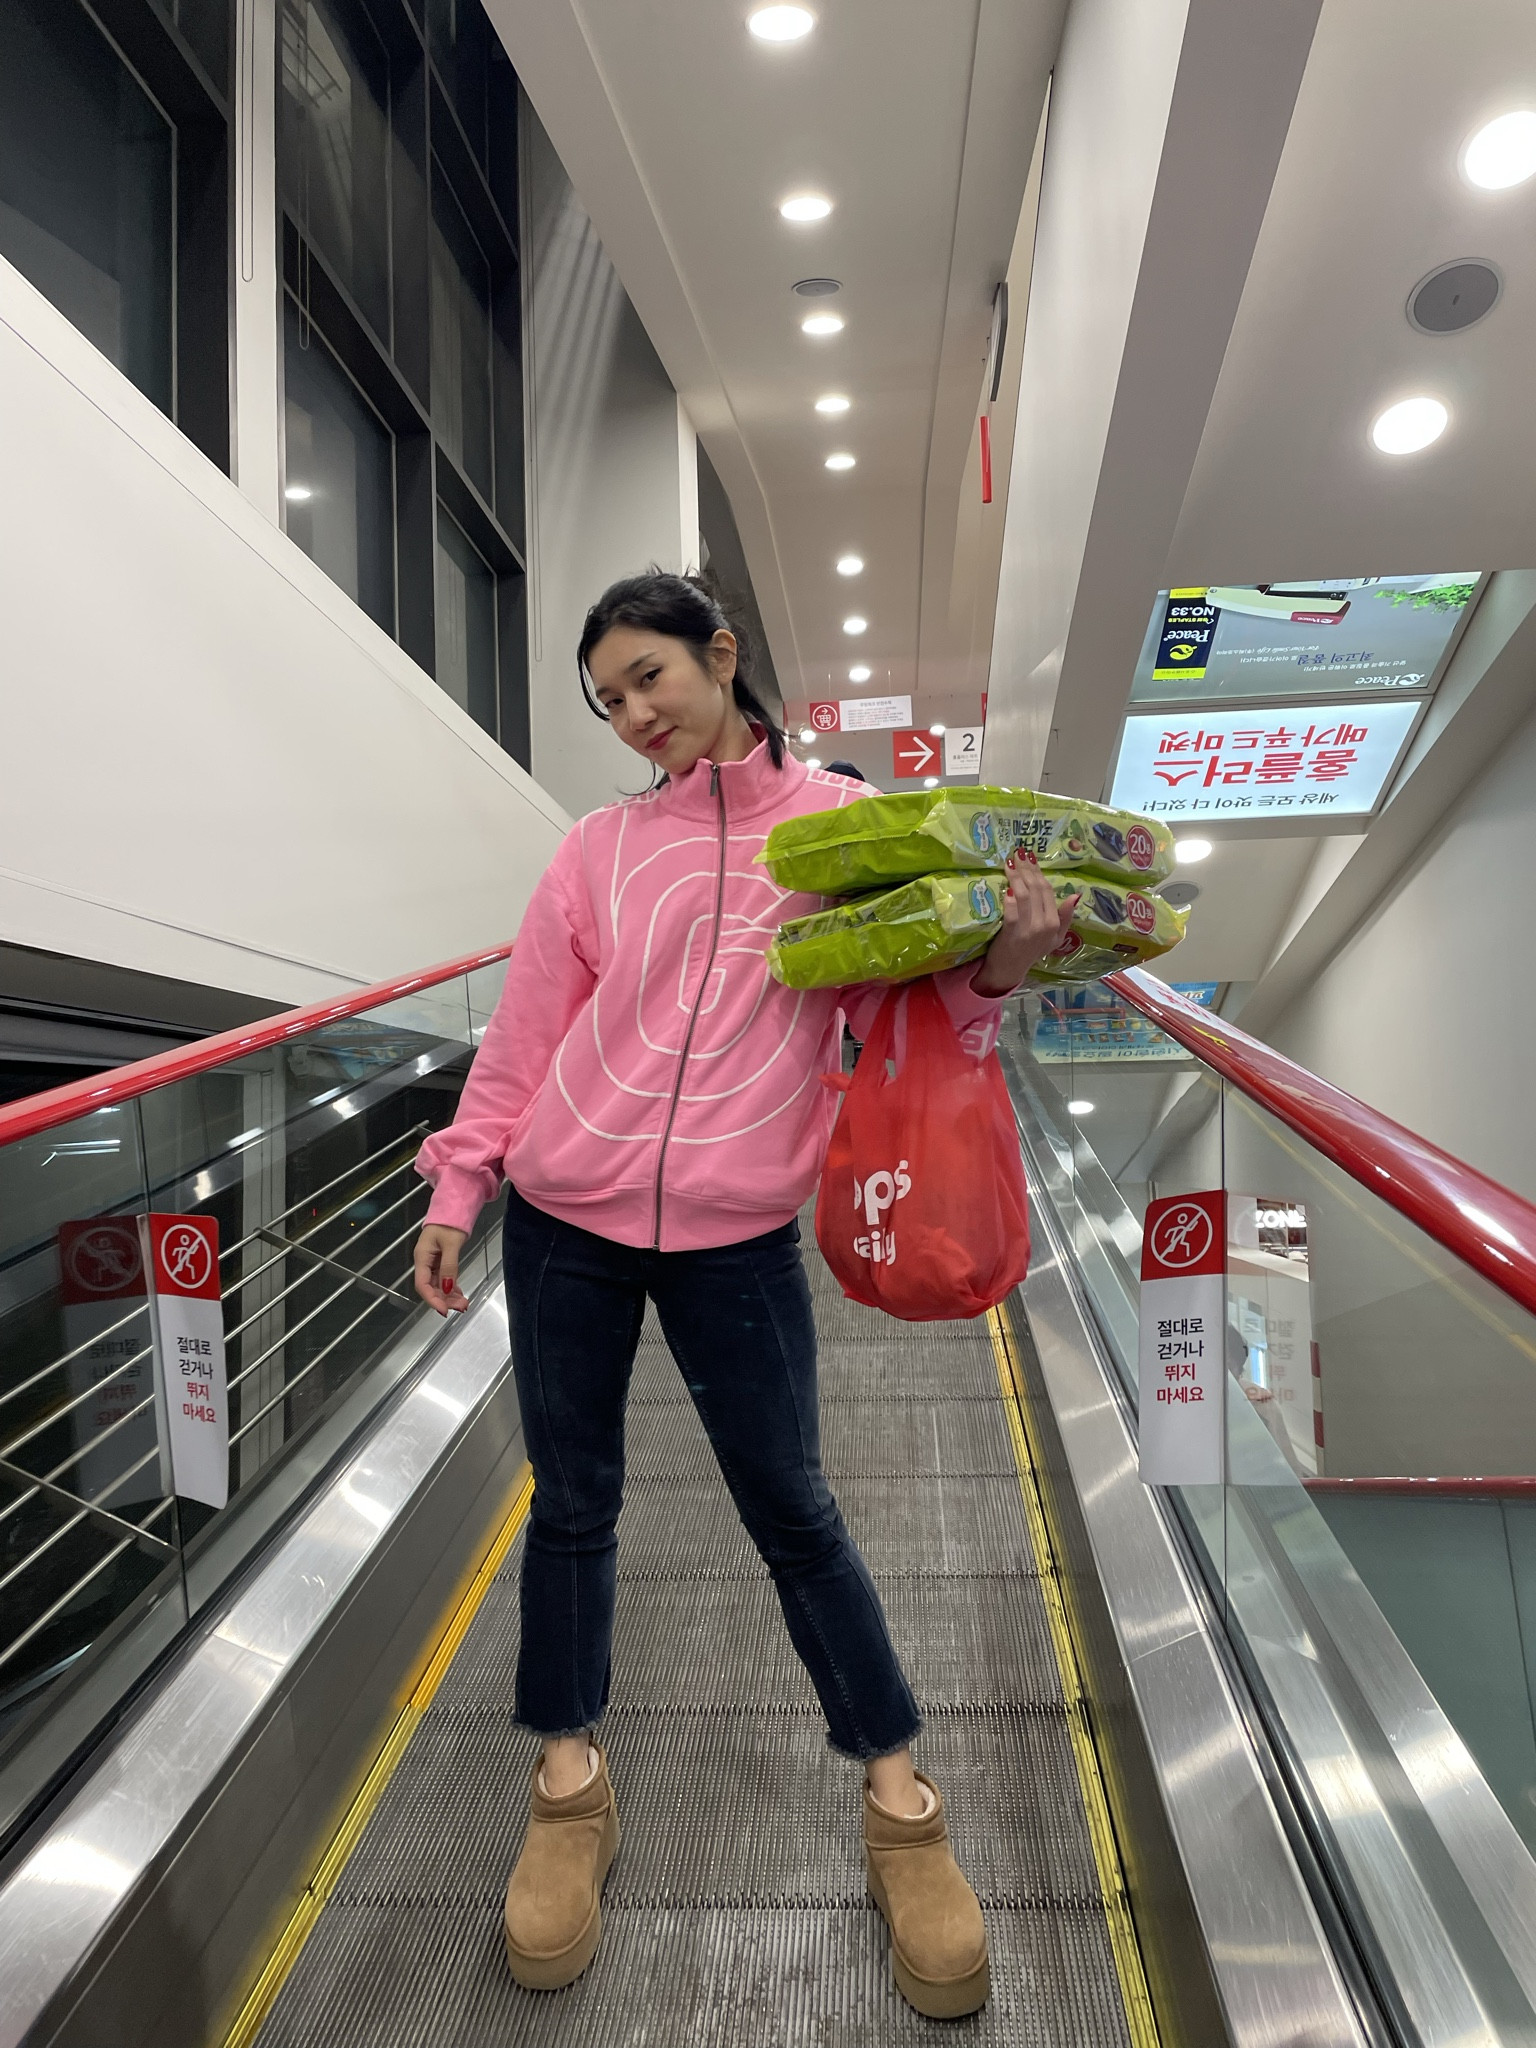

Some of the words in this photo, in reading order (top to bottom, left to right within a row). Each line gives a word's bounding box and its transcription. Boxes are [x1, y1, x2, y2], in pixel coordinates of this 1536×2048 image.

[1171, 606, 1215, 616] NO.33
[1166, 629, 1211, 642] Peace
[1330, 651, 1374, 664] 최고의
[1354, 675, 1401, 686] Peace
[962, 732, 975, 752] 2
[1158, 729, 1224, 753] 마켓
[1231, 726, 1297, 750] 푸드
[1301, 723, 1369, 747] 메가
[1152, 748, 1359, 788] 홈플러스
[1141, 798, 1188, 812] 있다!
[1190, 798, 1211, 810] 다
[1213, 796, 1253, 810] 맛이
[1257, 795, 1297, 808] 모든
[1299, 792, 1340, 806] 세상
[1013, 819, 1053, 836] 아보카도
[1156, 1318, 1204, 1336] 절대로
[176, 1336, 213, 1357] 절대로
[1156, 1341, 1204, 1360] 걷거나
[178, 1359, 214, 1380] 걷거나
[1164, 1363, 1196, 1382] 뛰지
[186, 1381, 209, 1401] 뛰지
[1156, 1386, 1205, 1405] 마세요
[182, 1402, 217, 1424] 마세요
